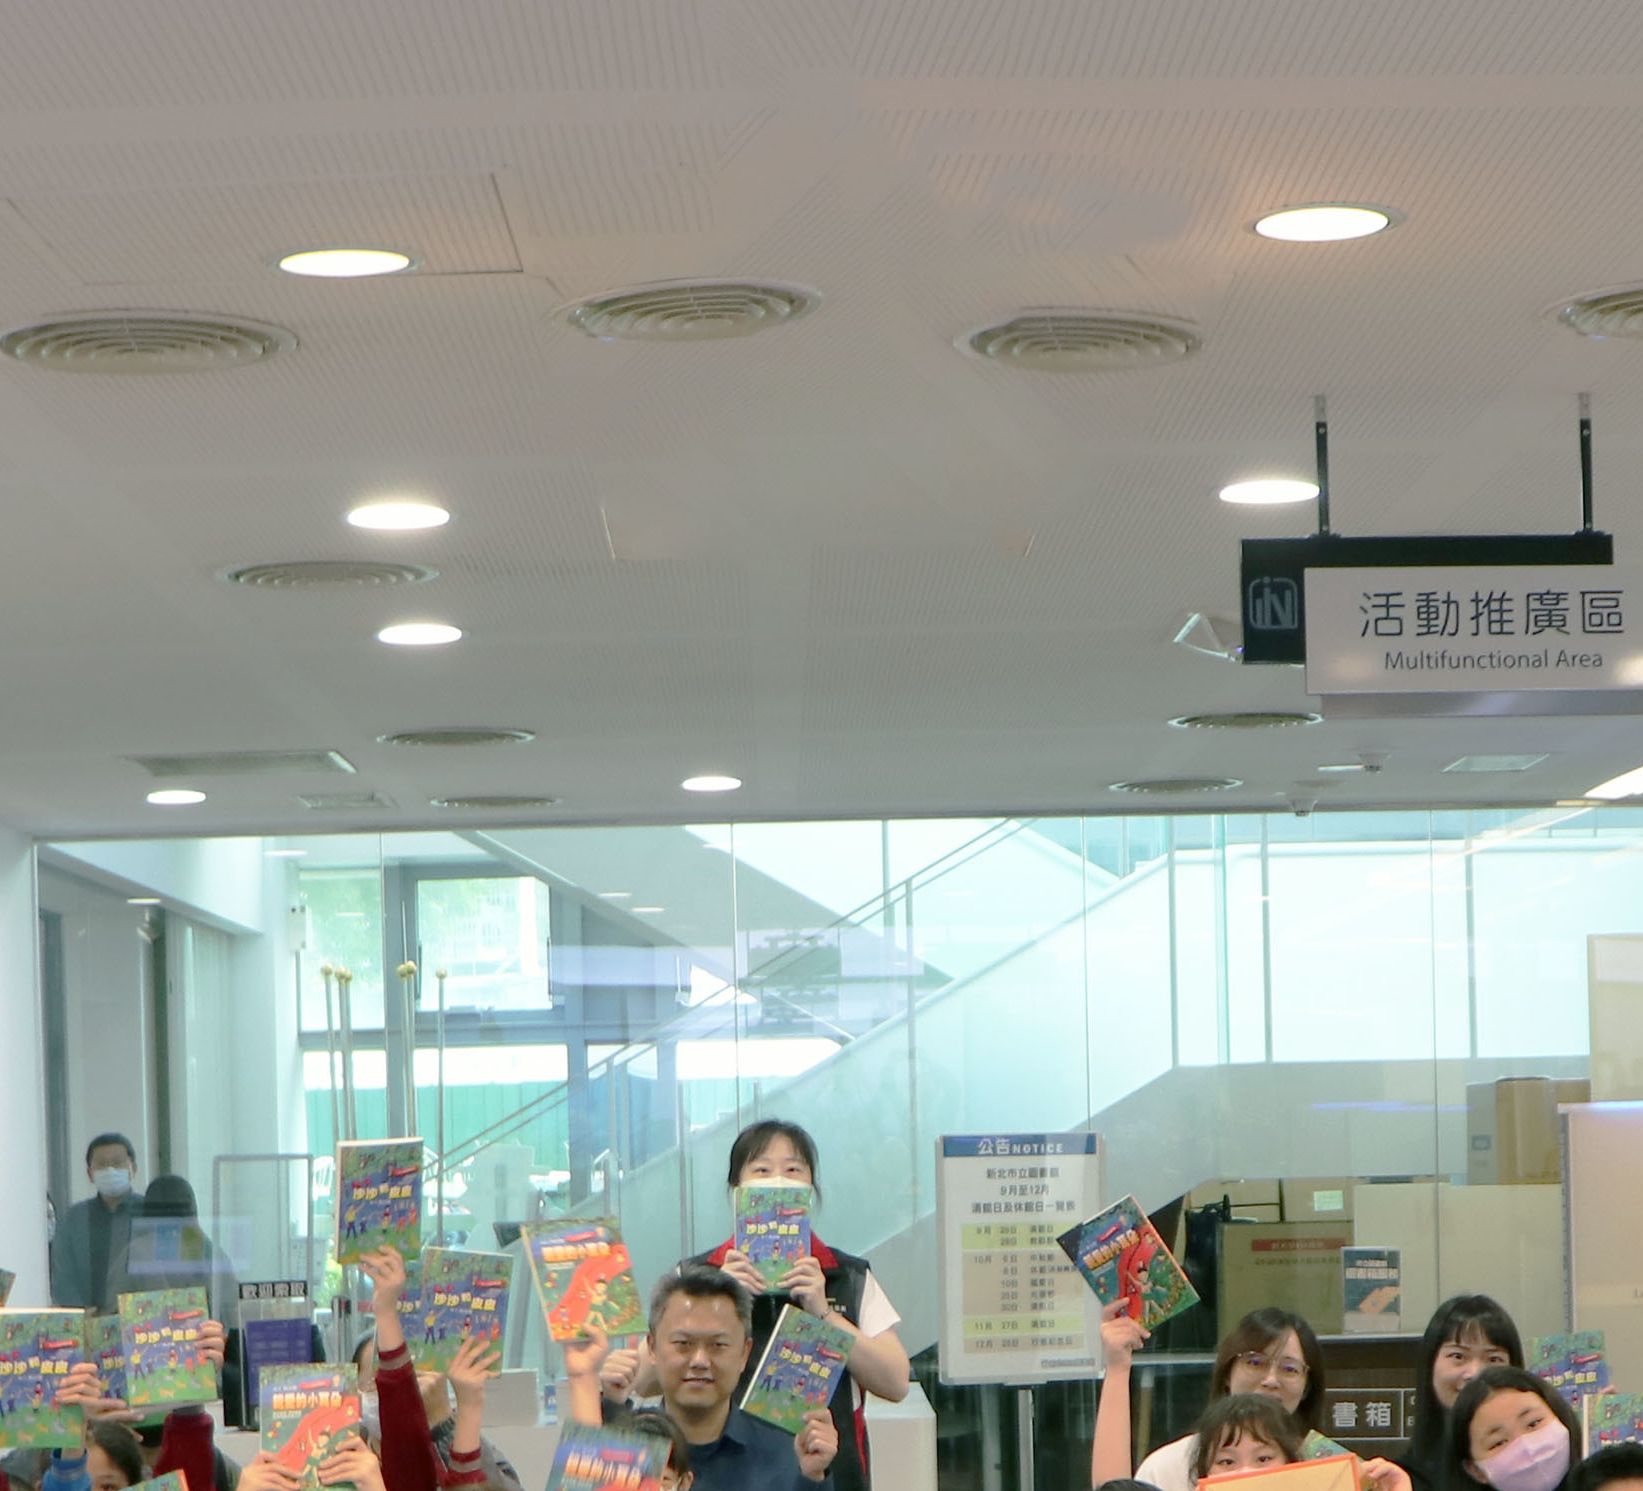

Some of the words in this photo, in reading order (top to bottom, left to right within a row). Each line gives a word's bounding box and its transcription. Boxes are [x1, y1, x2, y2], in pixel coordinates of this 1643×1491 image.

[1359, 588, 1626, 638] 活動推廣區
[1384, 649, 1550, 672] Multifunctional
[1556, 649, 1604, 671] Area
[978, 1138, 1009, 1155] 公告
[1013, 1144, 1063, 1153] NOTICE
[1332, 1401, 1391, 1427] 書箱
